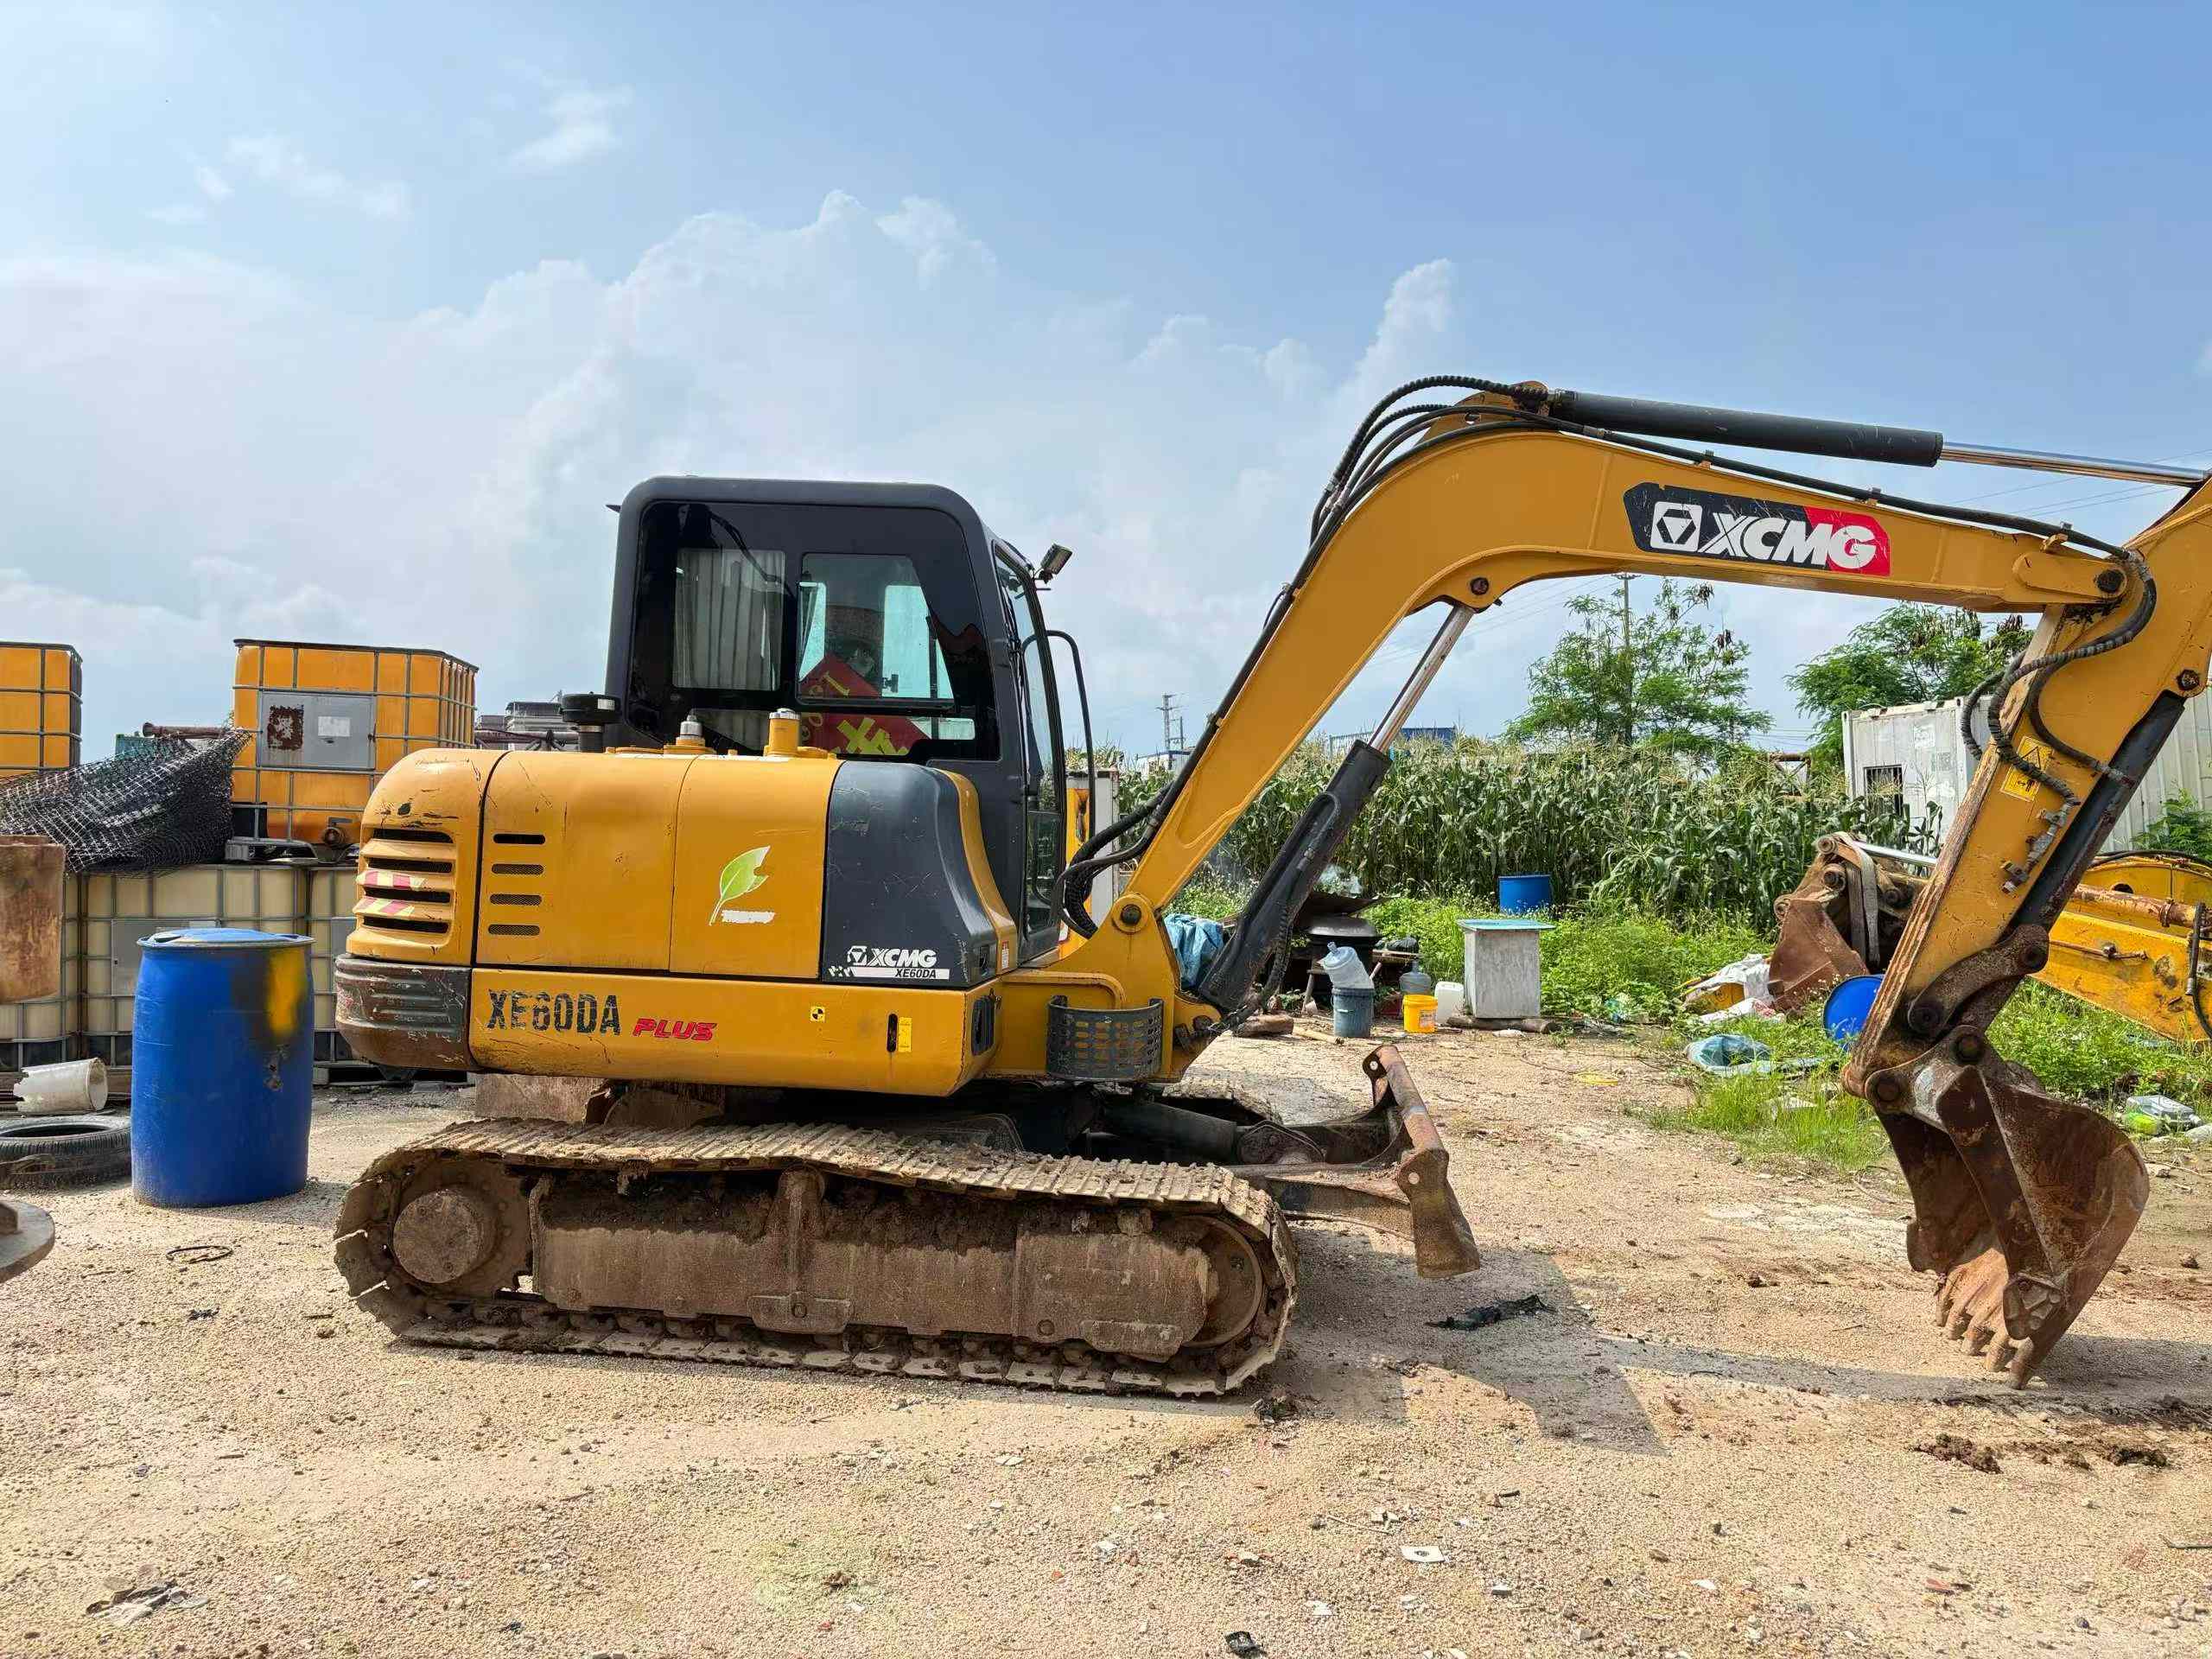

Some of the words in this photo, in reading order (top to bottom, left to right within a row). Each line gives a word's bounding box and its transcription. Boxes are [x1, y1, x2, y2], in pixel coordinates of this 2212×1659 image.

[1698, 512, 1877, 569] XCMG
[867, 948, 938, 968] XCMG
[895, 969, 937, 979] XE60DA
[632, 1018, 717, 1041] PLUS
